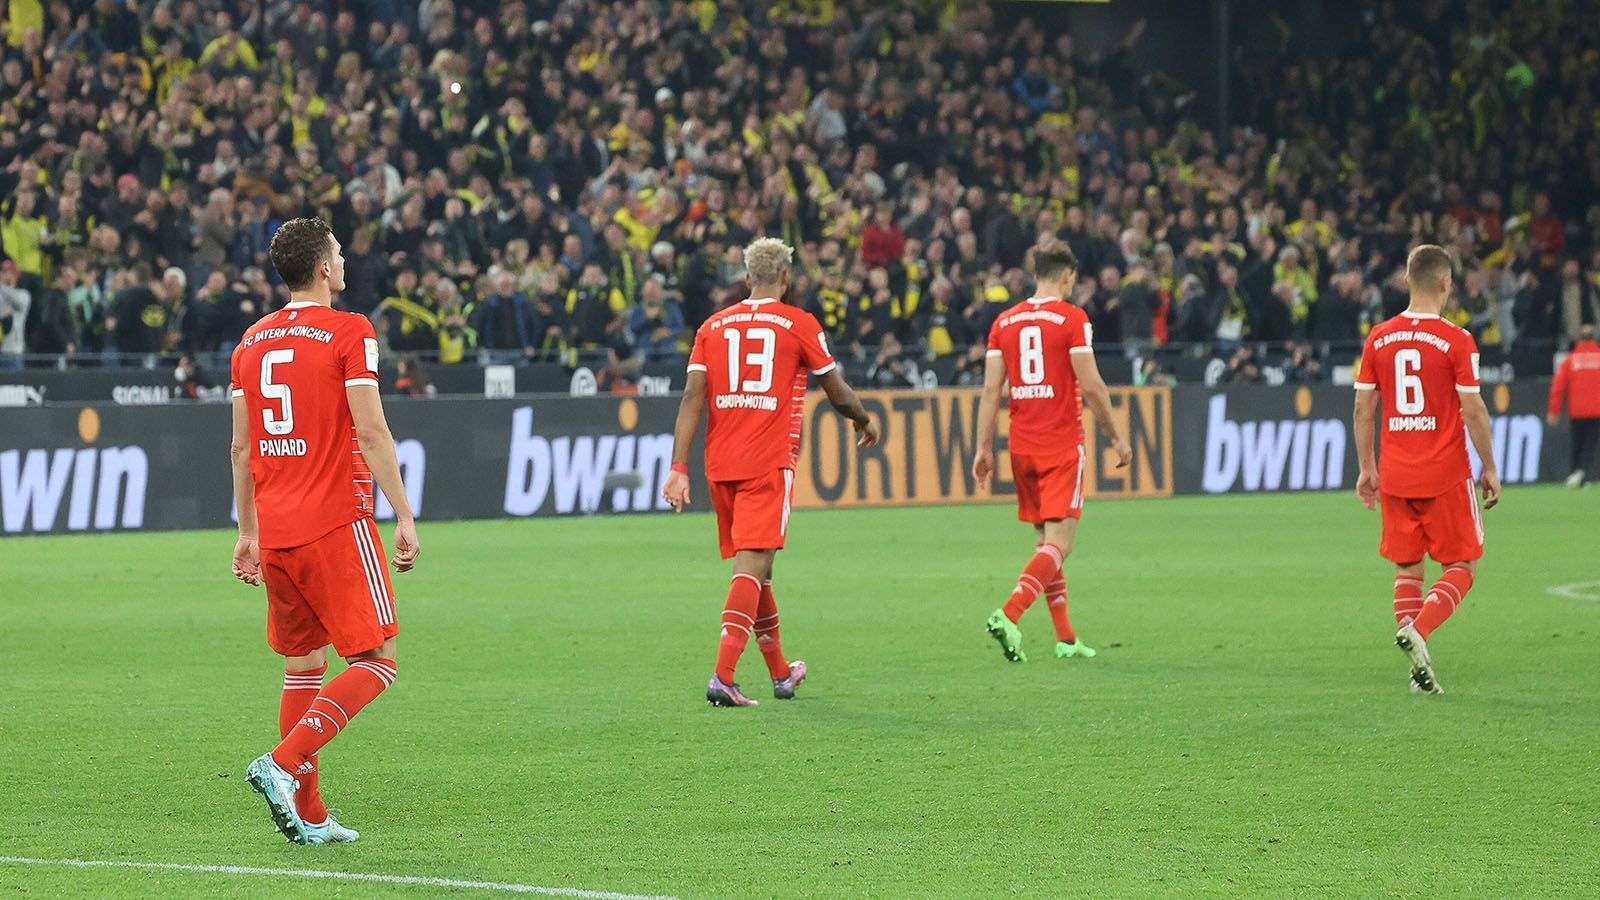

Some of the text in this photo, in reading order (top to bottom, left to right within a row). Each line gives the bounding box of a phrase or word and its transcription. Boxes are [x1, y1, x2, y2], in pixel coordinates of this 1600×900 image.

[243, 336, 254, 348] FC
[254, 327, 288, 343] BAYERN
[721, 313, 753, 326] BAYERN
[723, 327, 776, 393] 13
[1019, 325, 1044, 385] 8
[1373, 338, 1384, 351] FC
[1383, 330, 1414, 346] BAYERN
[260, 348, 294, 435] 5
[1394, 348, 1425, 415] 6
[715, 394, 778, 411] CHUPO-MOTING
[1202, 386, 1346, 493] bwin
[1388, 416, 1436, 432] KIMMICH
[259, 438, 307, 457] PAVARD
[504, 399, 674, 516] bwin
